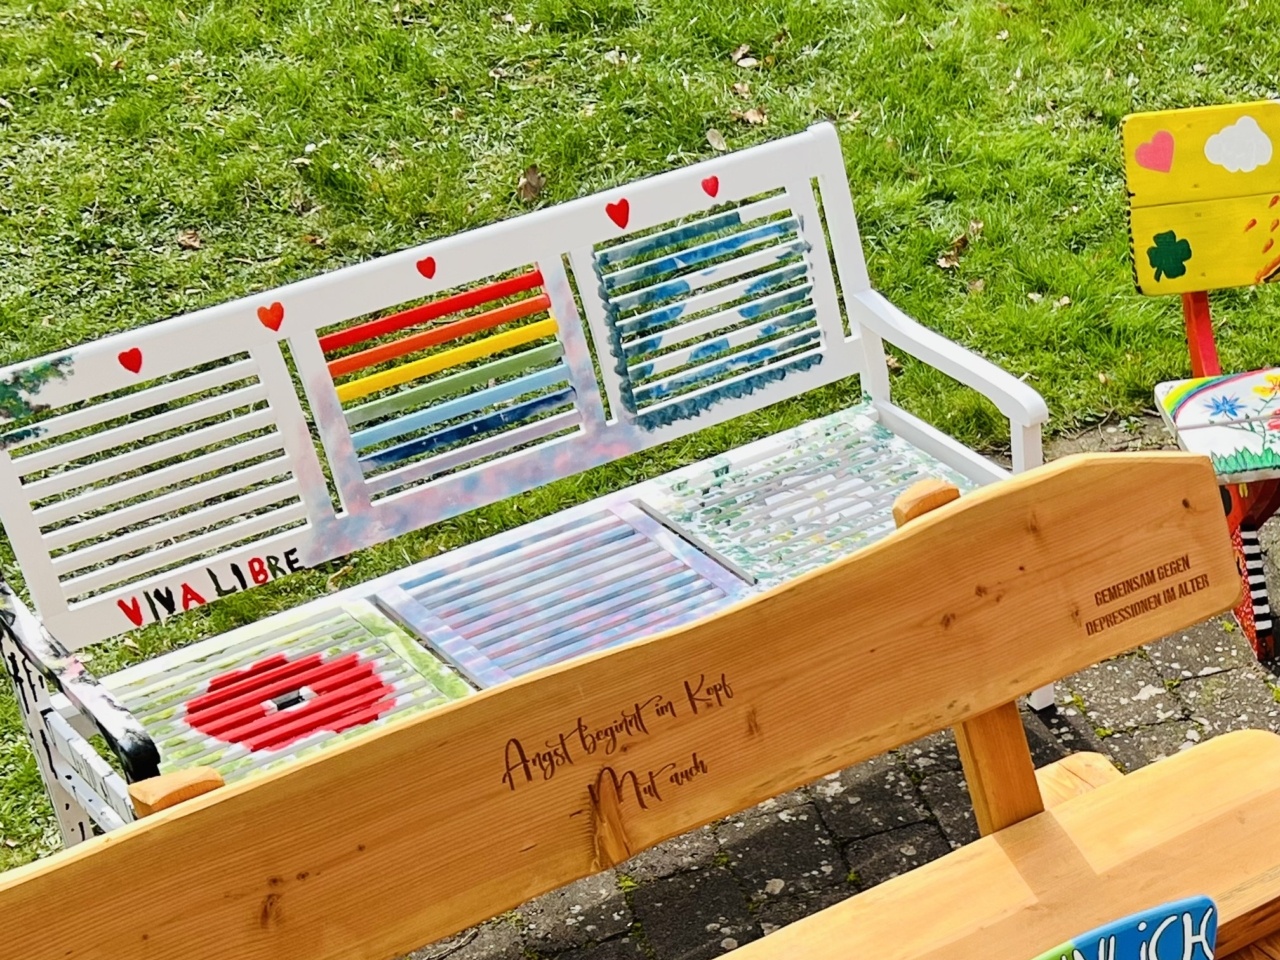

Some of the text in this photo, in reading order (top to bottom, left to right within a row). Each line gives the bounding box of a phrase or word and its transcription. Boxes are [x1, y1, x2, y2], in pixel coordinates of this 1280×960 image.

[117, 547, 306, 627] VIVA LIBRE
[1085, 573, 1210, 636] DEPRESSIONEN IM ALTER
[1094, 554, 1191, 607] GEMEINSAM GEGEN
[501, 722, 574, 792] Angst
[684, 673, 734, 715] Kopf
[587, 766, 668, 810] Mut
